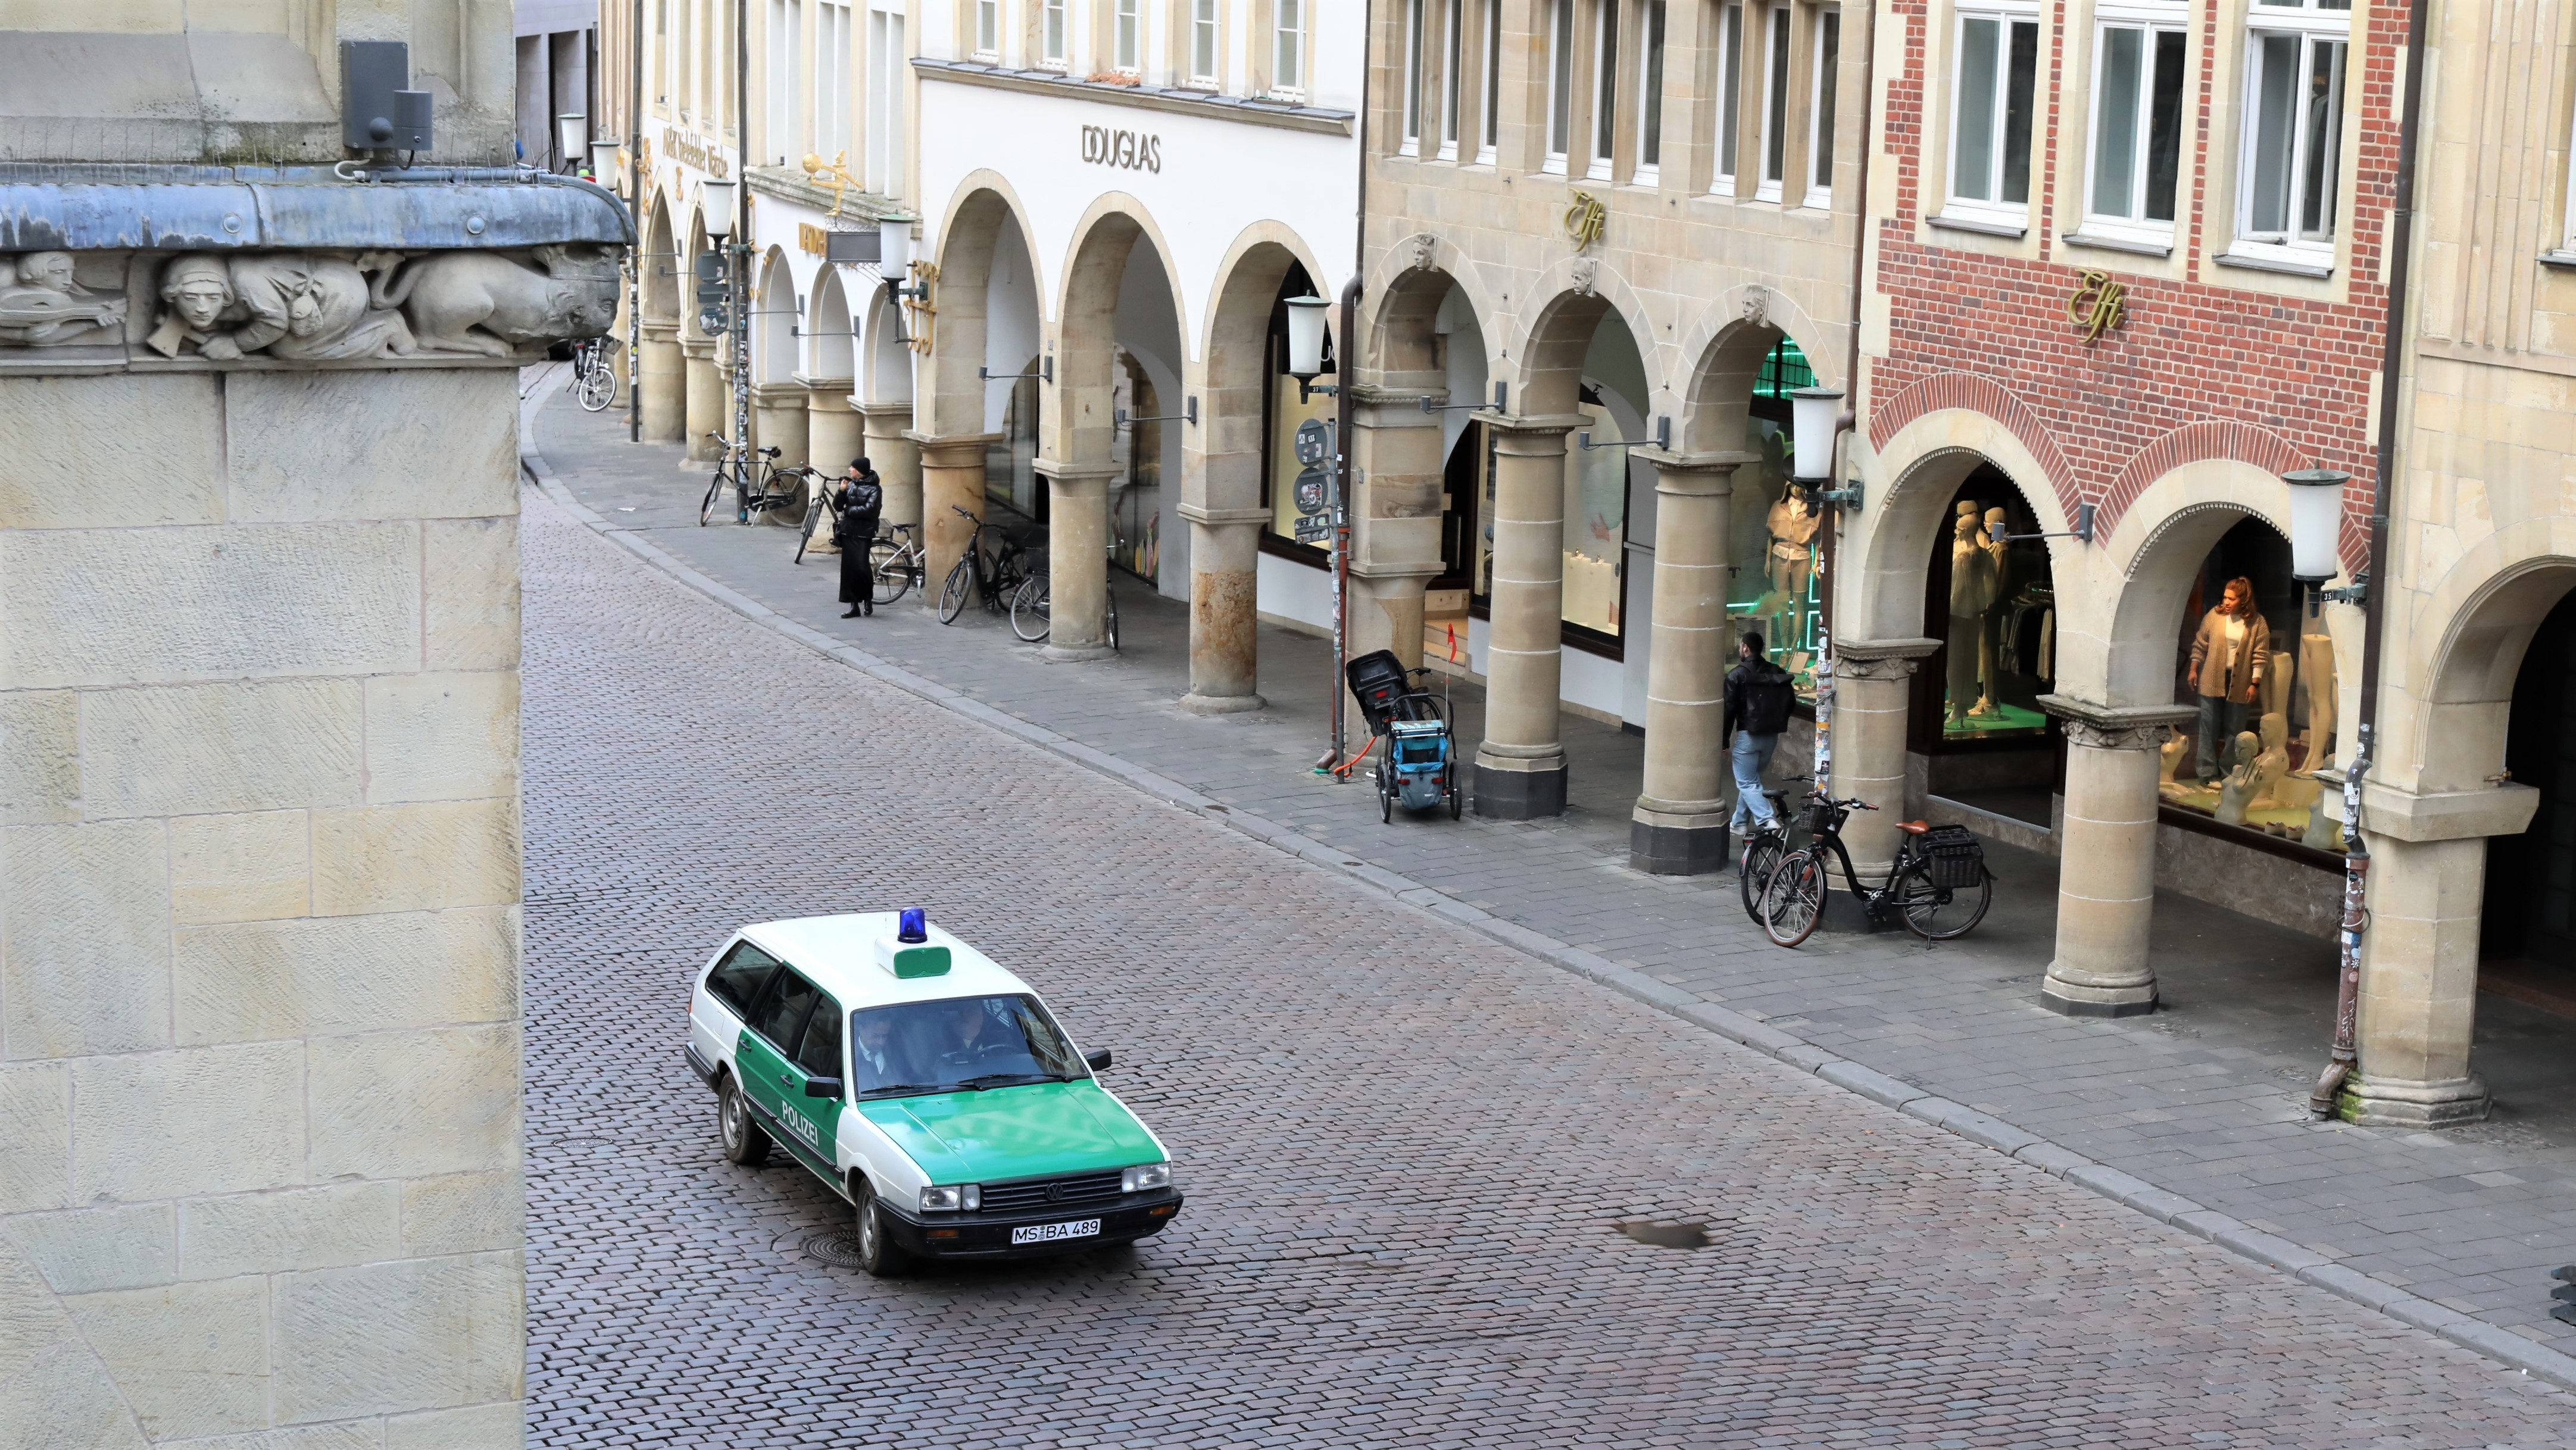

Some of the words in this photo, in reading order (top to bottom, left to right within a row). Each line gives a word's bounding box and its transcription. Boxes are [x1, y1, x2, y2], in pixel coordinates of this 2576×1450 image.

[1082, 124, 1160, 174] DOUGLAS
[1563, 188, 1605, 252] Elfi
[2069, 268, 2124, 343] Elfi
[2324, 592, 2332, 601] 35
[782, 1099, 819, 1147] POLIZEI
[1072, 1220, 1098, 1235] 489
